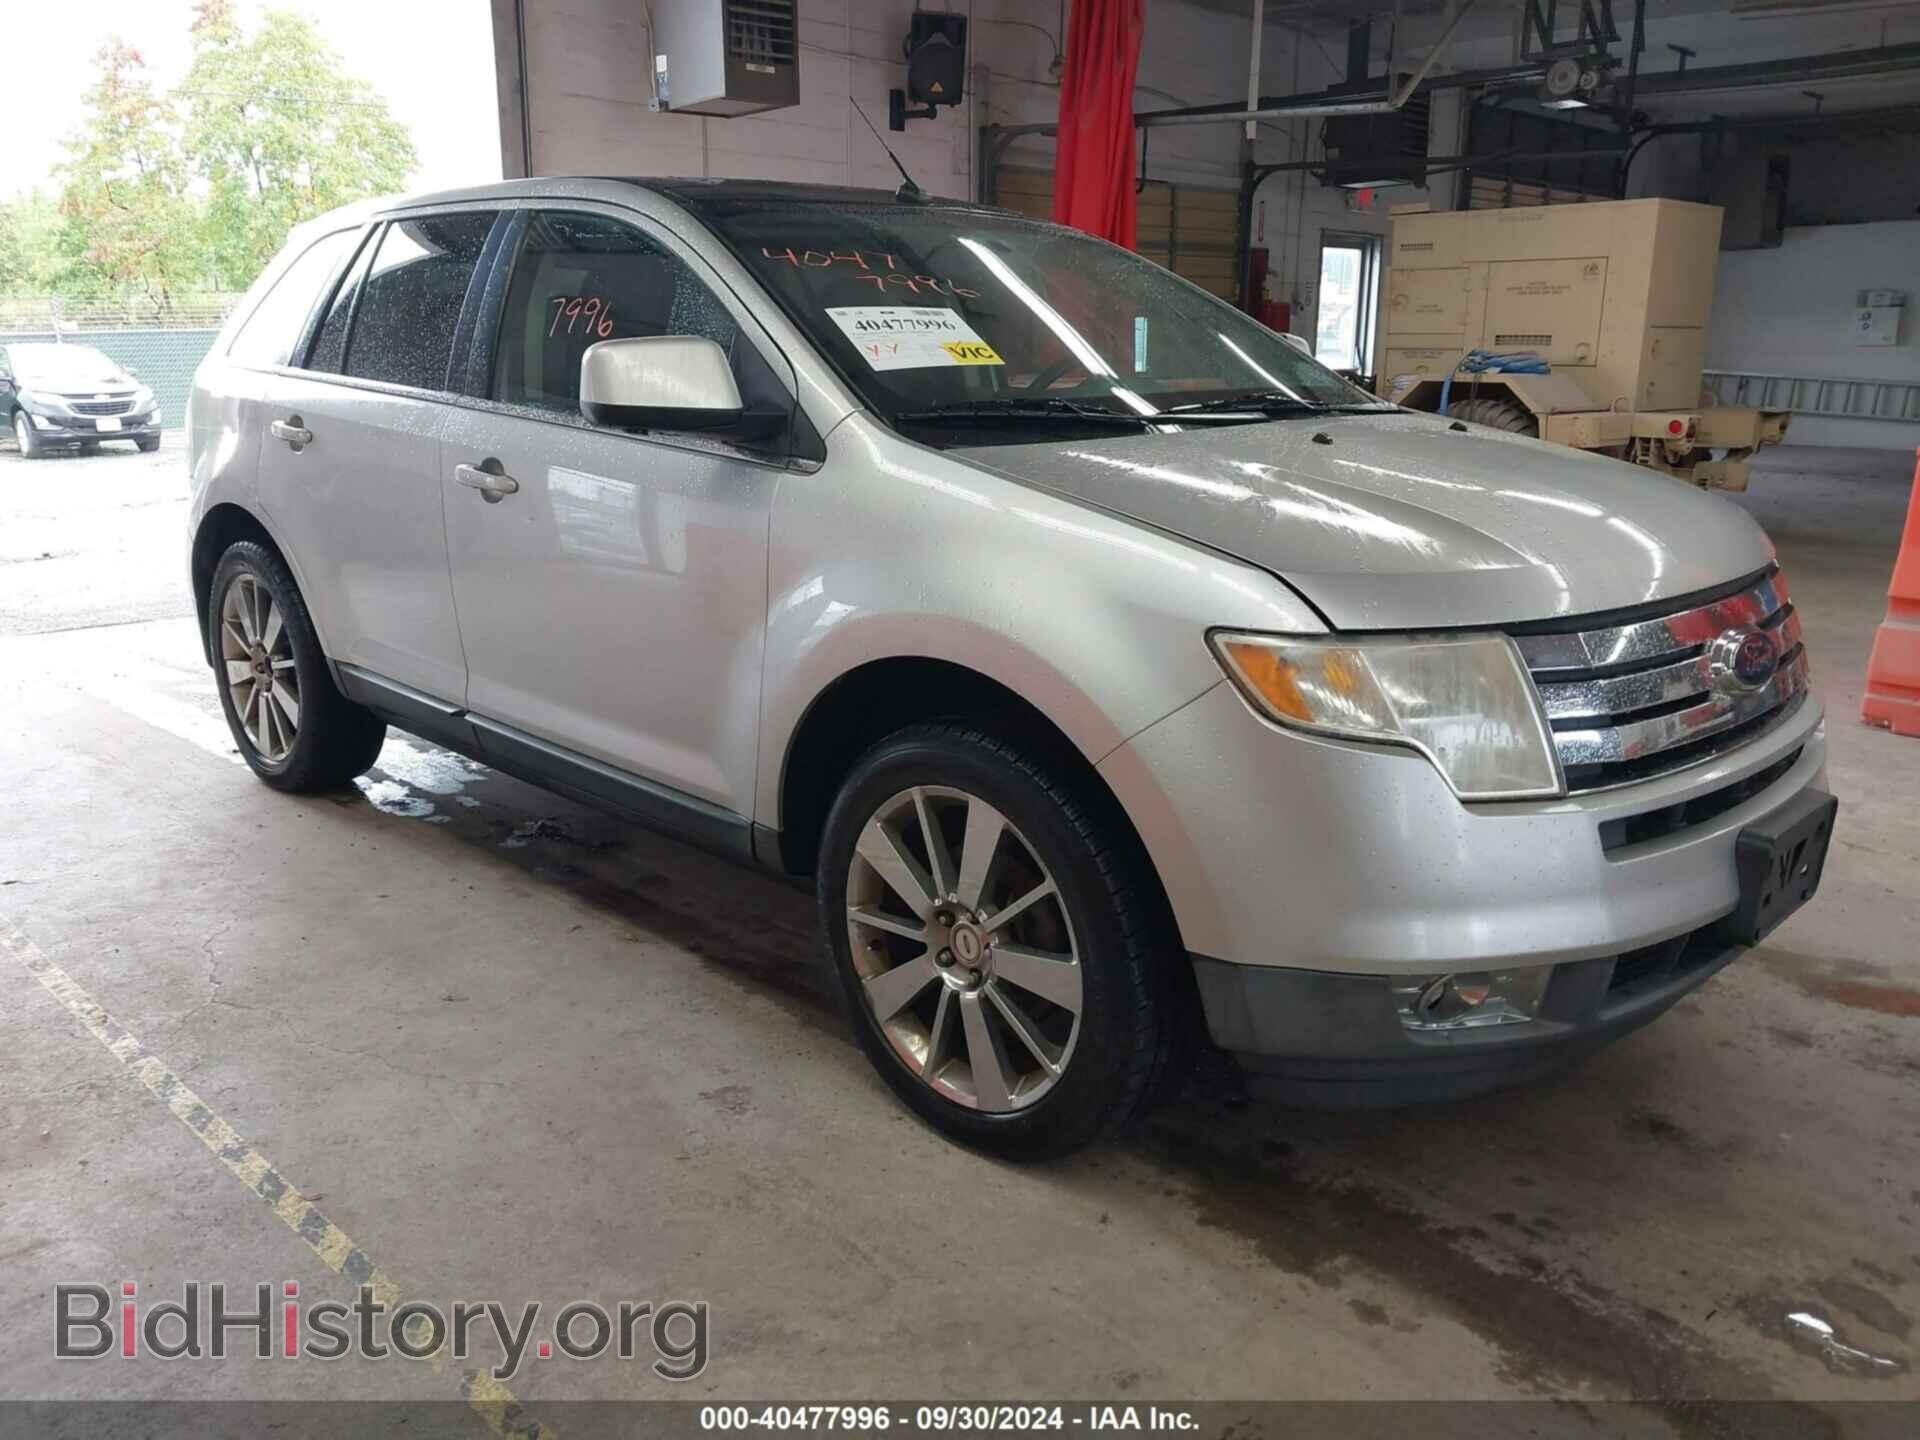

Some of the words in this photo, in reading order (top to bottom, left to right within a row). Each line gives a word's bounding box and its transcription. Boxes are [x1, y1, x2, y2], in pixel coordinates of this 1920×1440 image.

[762, 248, 895, 270] 4047
[856, 273, 980, 298] 7996
[548, 297, 613, 337] 7996
[855, 319, 957, 332] 40477996
[949, 345, 994, 359] VIC
